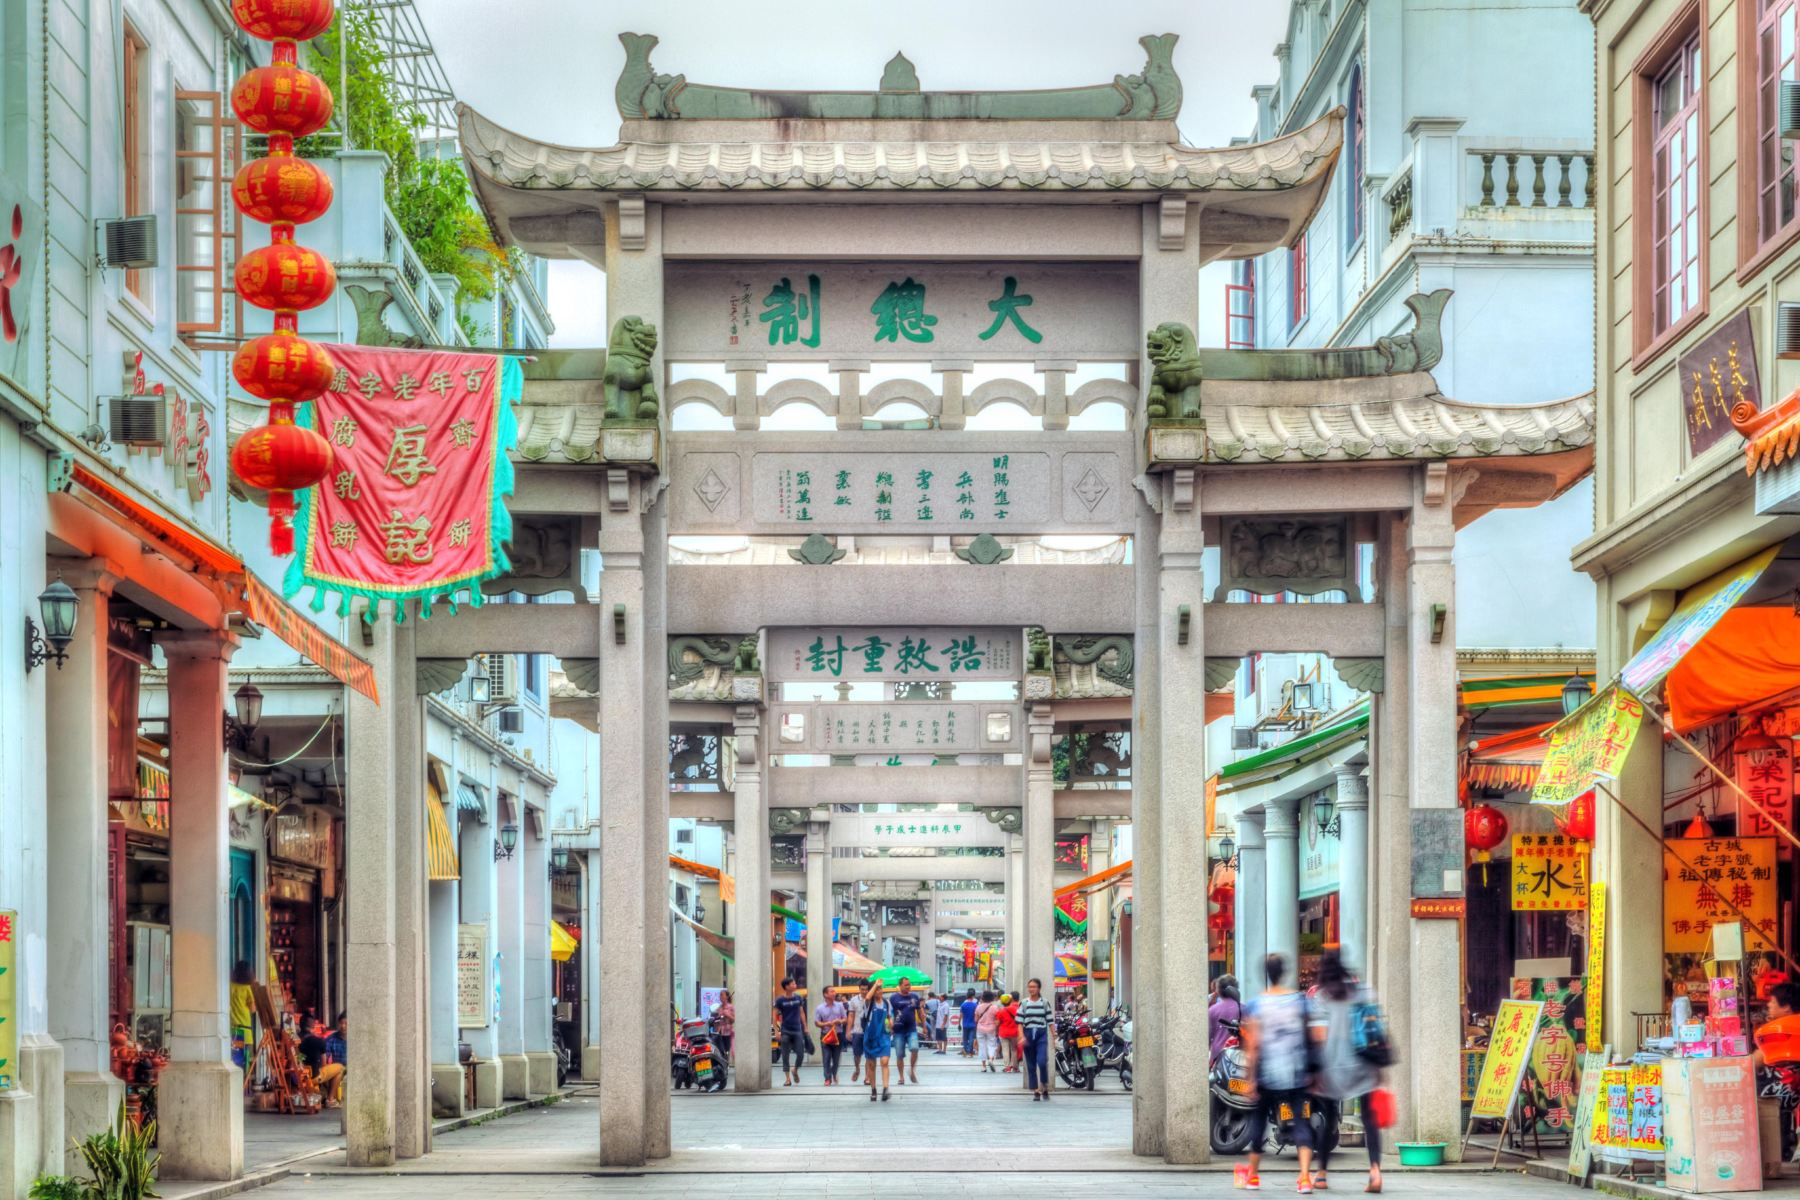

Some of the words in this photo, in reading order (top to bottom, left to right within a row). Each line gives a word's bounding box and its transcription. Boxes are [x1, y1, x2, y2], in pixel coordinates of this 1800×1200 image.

[383, 424, 437, 564] 厚記
[1530, 858, 1572, 899] 水
[1540, 999, 1573, 1128] 老字号佛手
